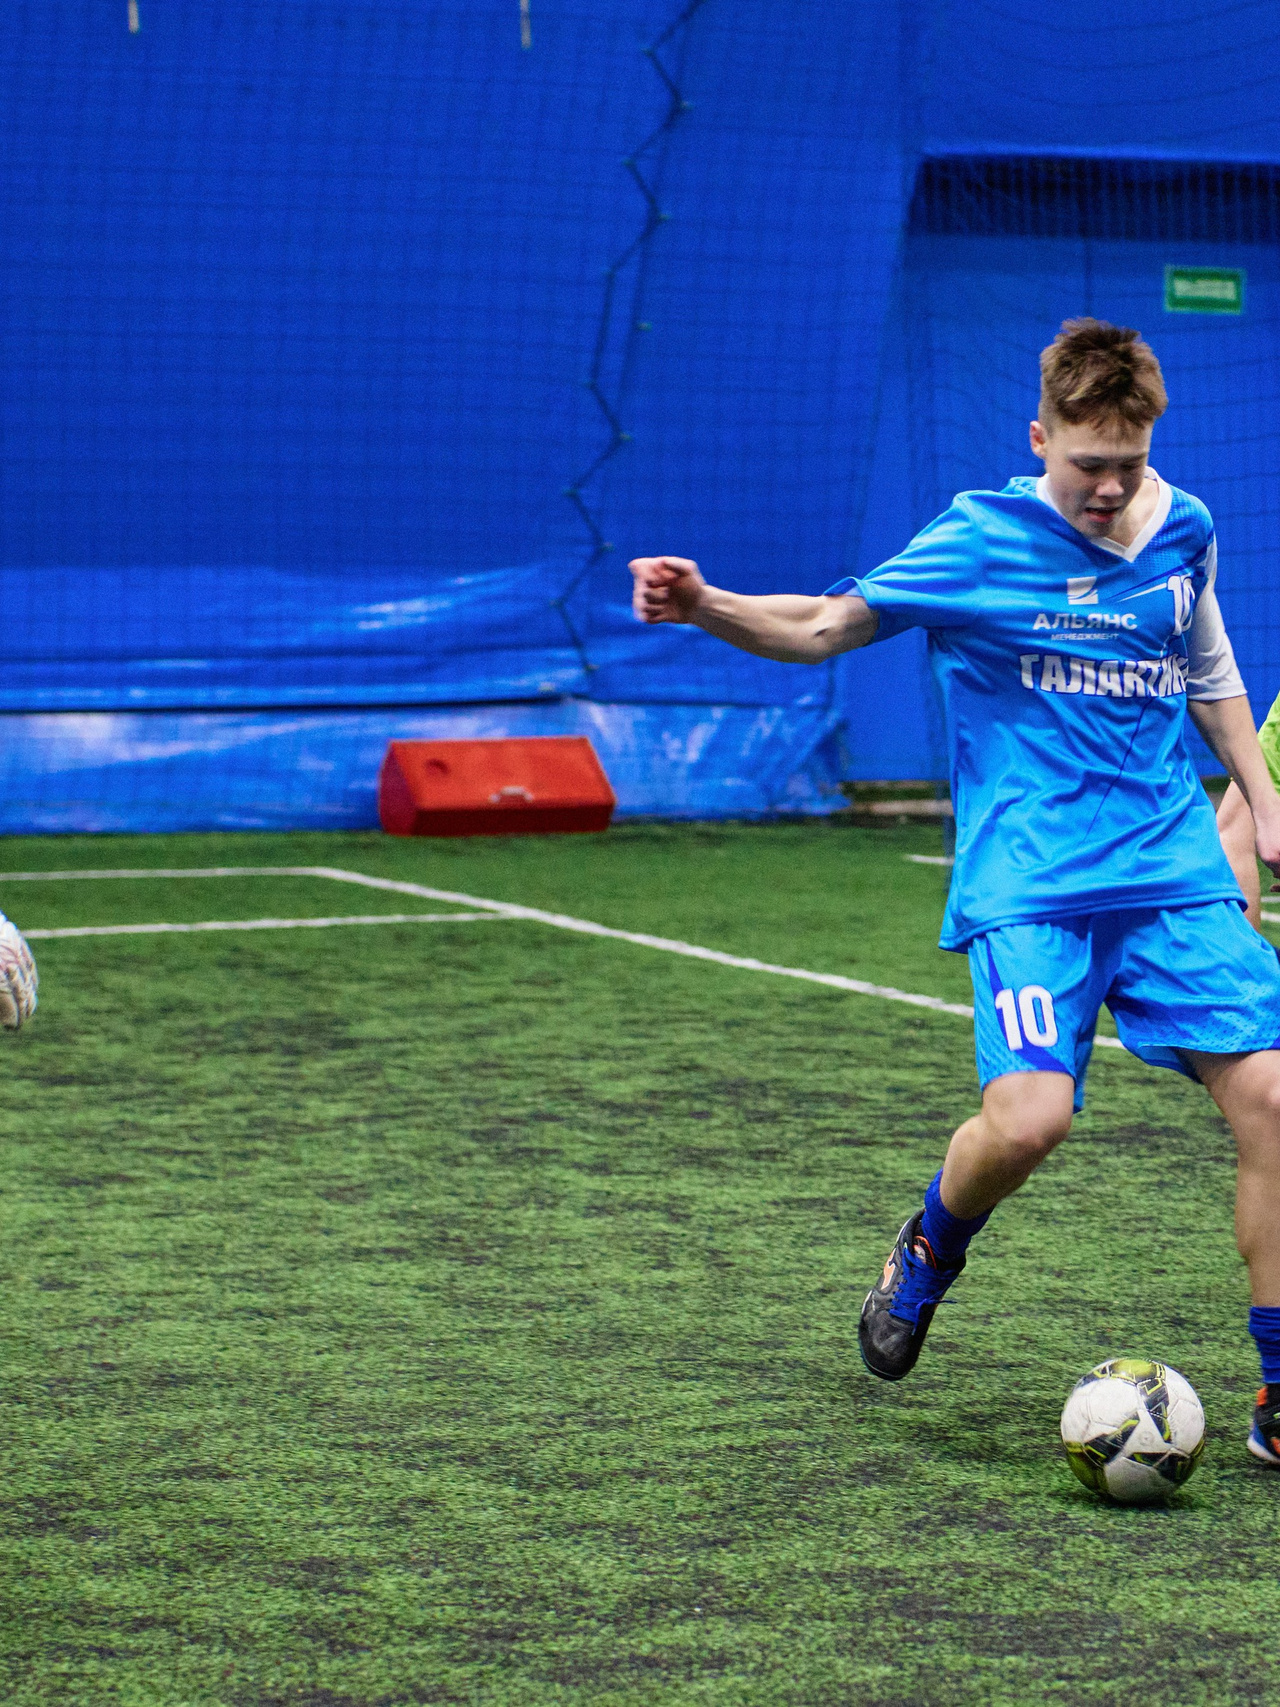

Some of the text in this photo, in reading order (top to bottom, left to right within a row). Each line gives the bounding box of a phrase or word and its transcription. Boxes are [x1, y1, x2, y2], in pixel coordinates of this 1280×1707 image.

[1033, 613, 1138, 630] АЛЬЯНС
[1167, 573, 1196, 636] 10
[1051, 633, 1119, 641] МЕНЕДЖМЕНТ
[995, 984, 1059, 1051] 10
